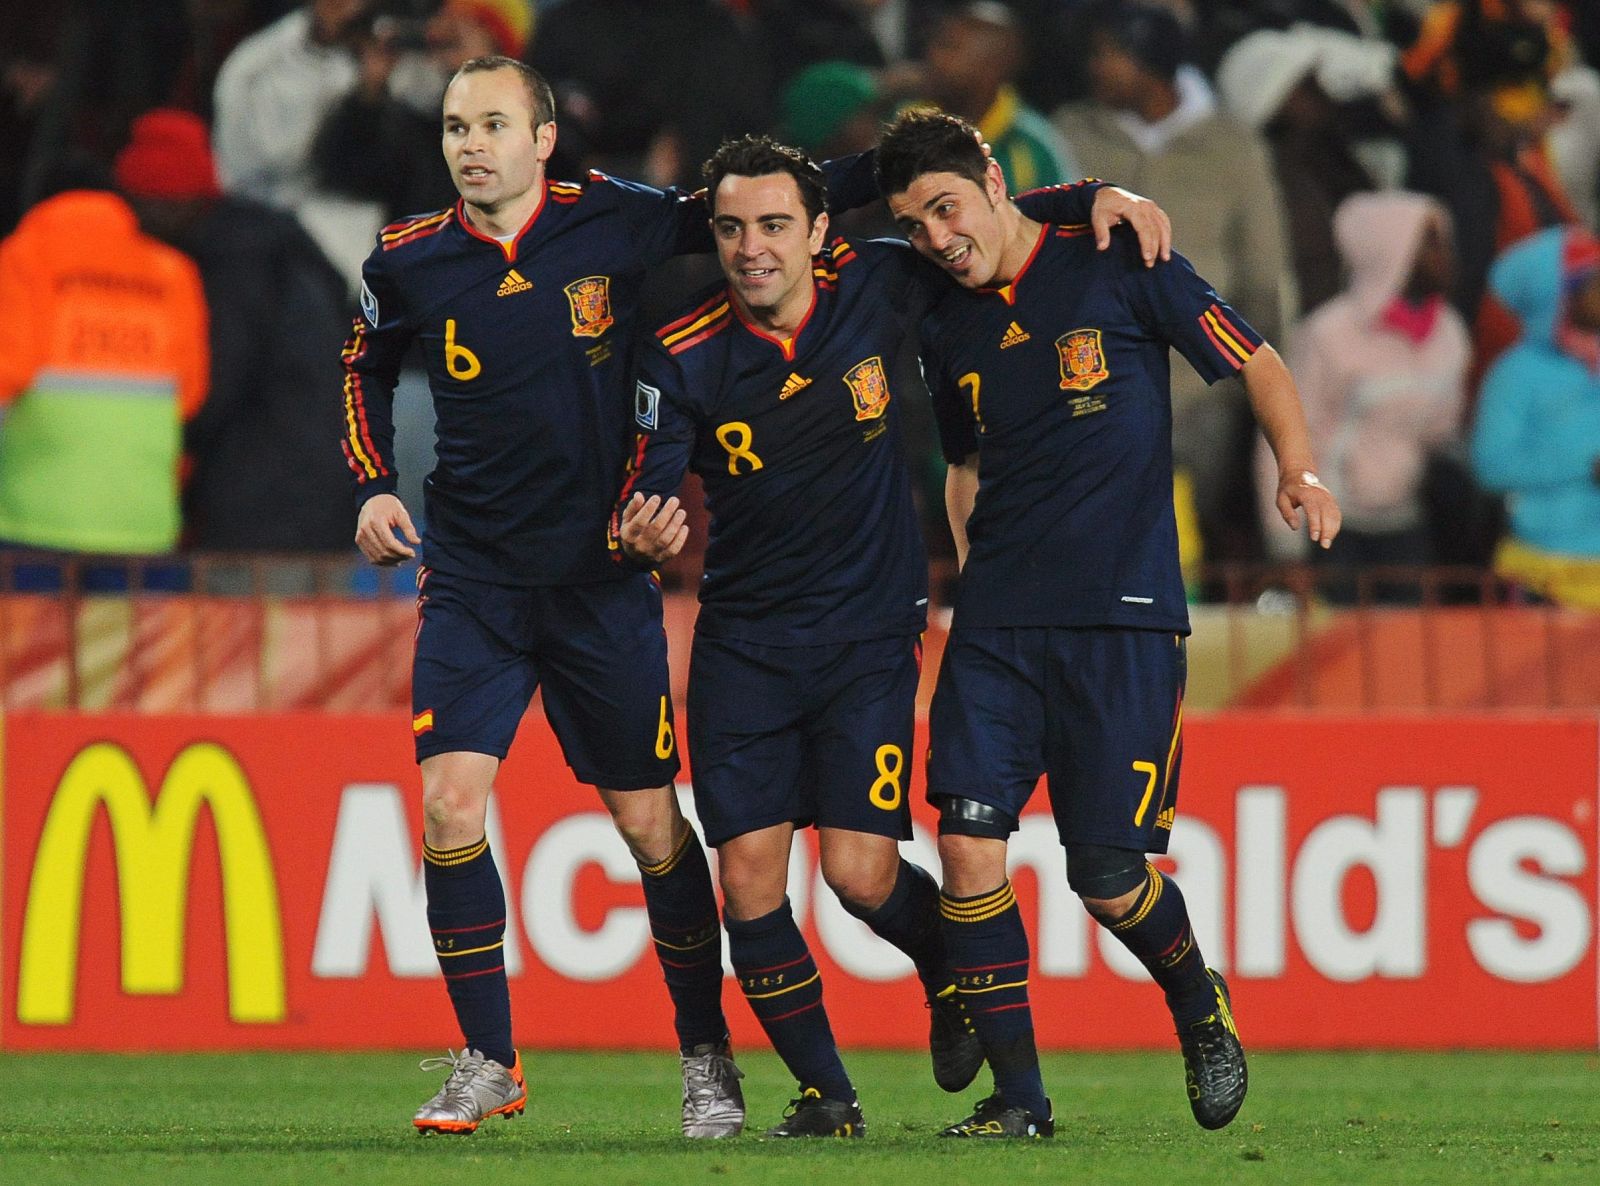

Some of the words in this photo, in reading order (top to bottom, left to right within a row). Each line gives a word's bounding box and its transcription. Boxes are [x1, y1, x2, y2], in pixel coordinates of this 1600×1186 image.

[496, 281, 533, 297] adidas
[445, 318, 481, 380] 6
[1000, 332, 1031, 349] adidas
[958, 371, 986, 433] 7
[715, 421, 764, 476] 8
[655, 695, 673, 760] 6
[868, 743, 903, 811] 8
[1132, 760, 1157, 827] 7
